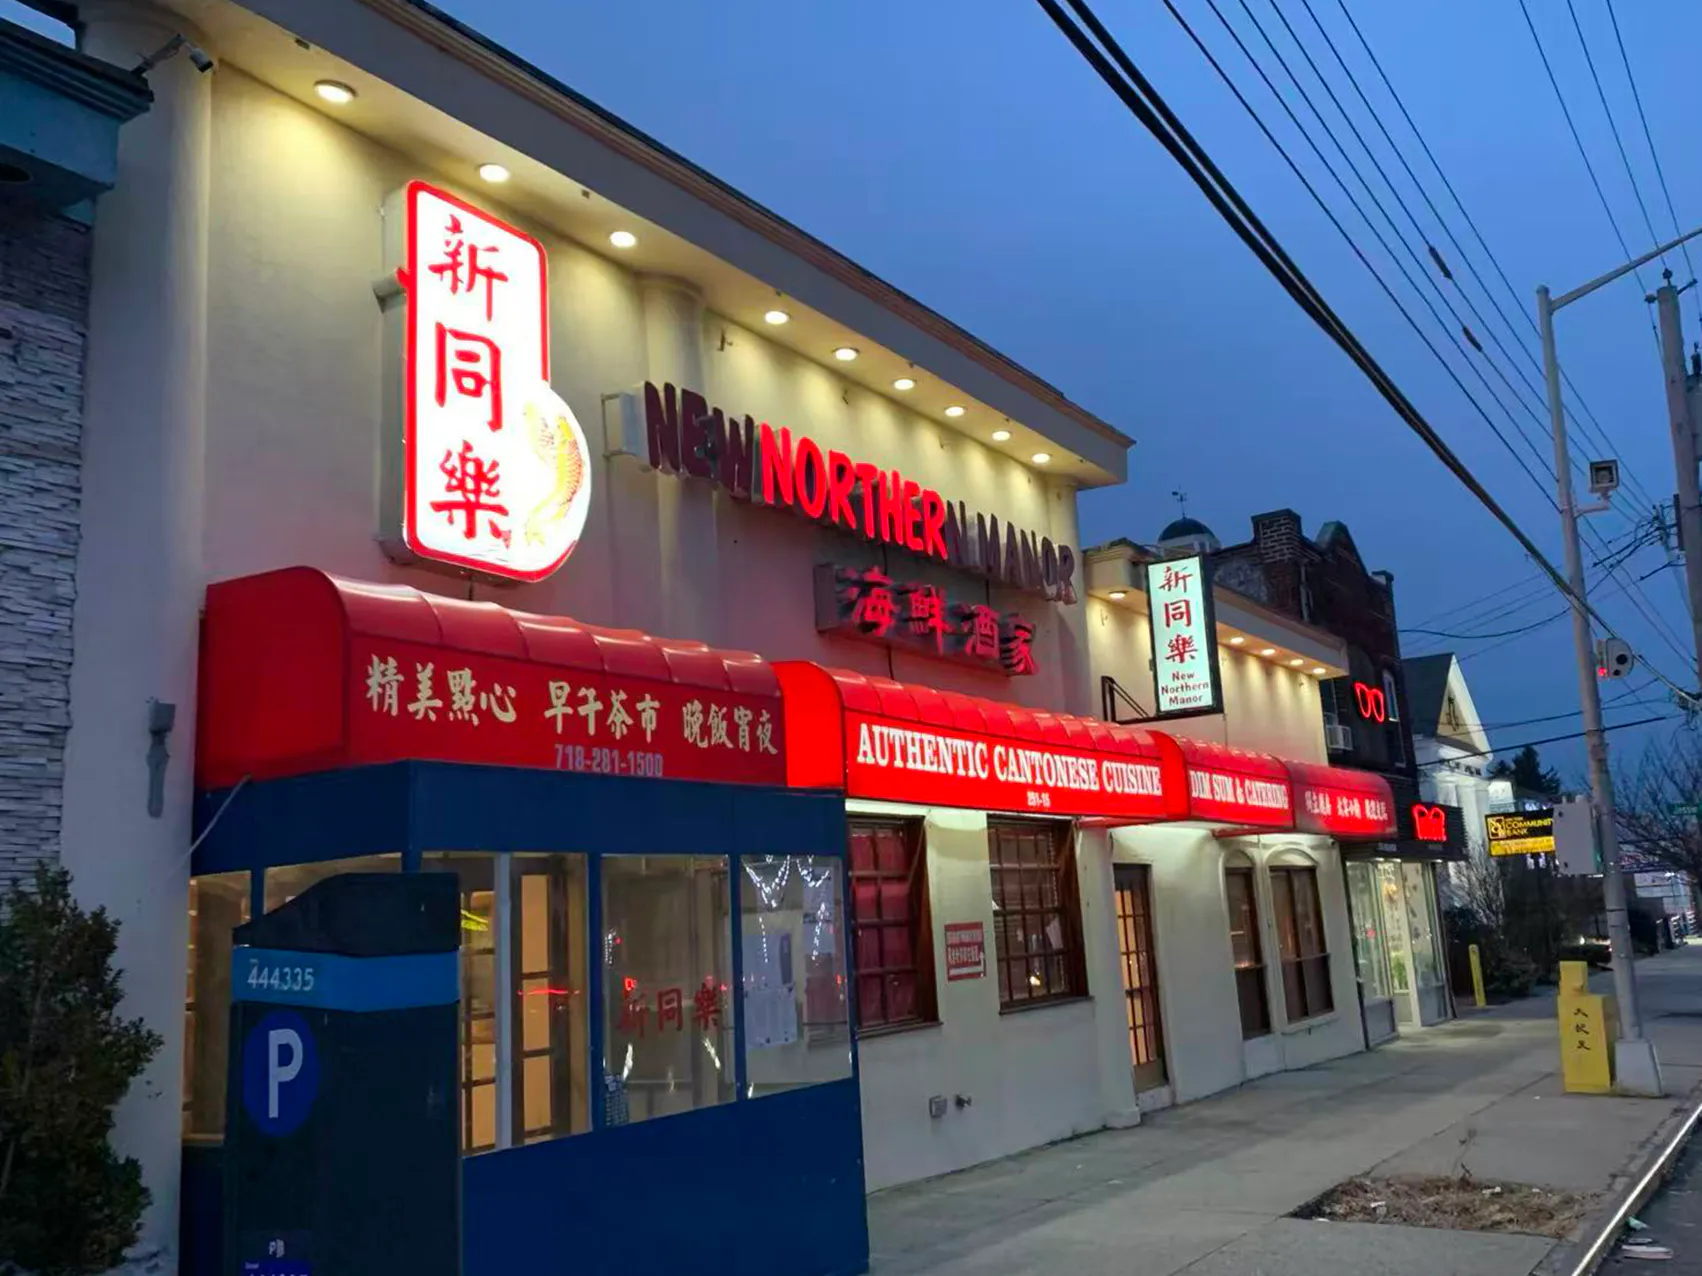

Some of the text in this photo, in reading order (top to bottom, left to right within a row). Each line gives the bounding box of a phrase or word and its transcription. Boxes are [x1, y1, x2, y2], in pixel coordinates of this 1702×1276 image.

[428, 214, 511, 548] 新同樂
[643, 381, 1076, 602] NEW NORTHERN MANOR
[843, 566, 1040, 676] 海鮮酒家
[1158, 565, 1198, 664] 新同樂
[366, 653, 518, 726] 精美點心
[1161, 680, 1210, 695] Northern
[1169, 694, 1203, 706] Manor
[1172, 671, 1195, 681] New
[554, 743, 664, 777] 718-281-1500
[856, 723, 1163, 796] AUTHENTIC CANTONESE CUISINE
[1189, 770, 1212, 799] DIM
[1212, 774, 1235, 803] SUM
[1235, 777, 1245, 805] &
[1244, 779, 1290, 810] CATERING
[247, 965, 315, 992] 444335
[268, 1028, 304, 1119] P
